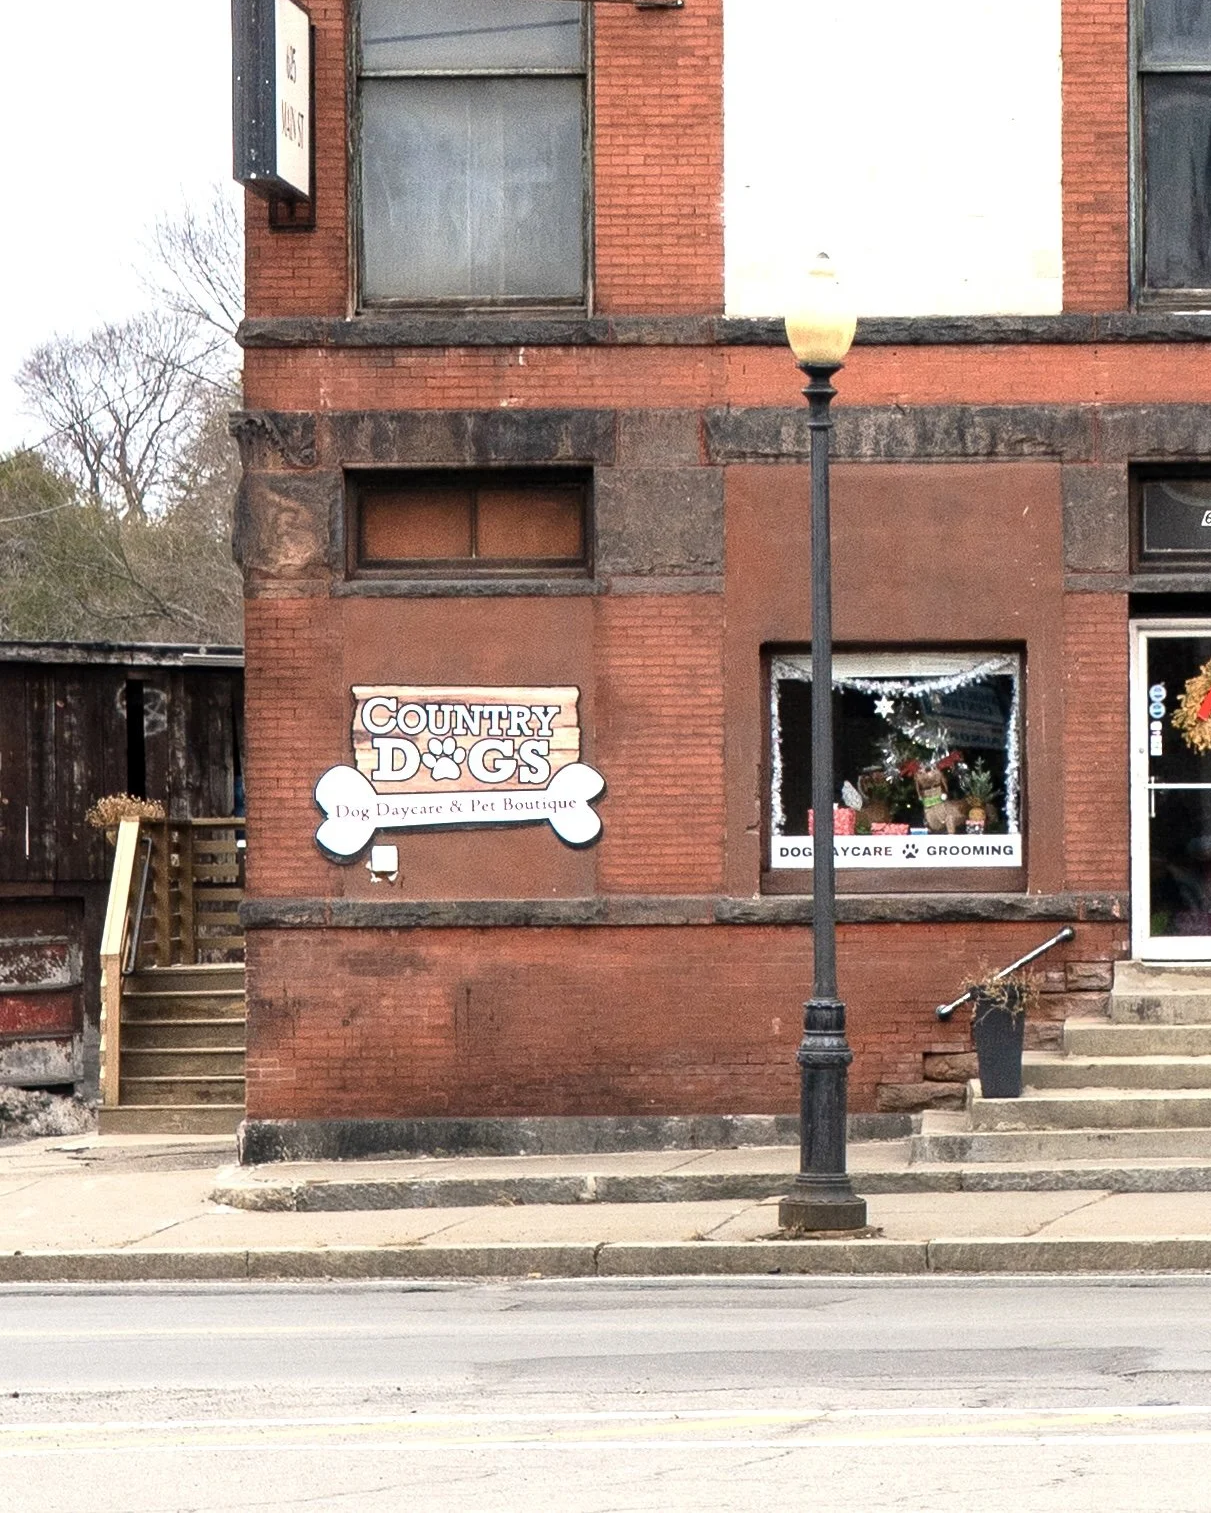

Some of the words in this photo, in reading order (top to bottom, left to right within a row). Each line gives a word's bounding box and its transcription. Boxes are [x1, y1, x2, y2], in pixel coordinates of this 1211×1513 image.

[361, 696, 561, 736] COUNTRY
[336, 803, 370, 820] Dog
[376, 802, 443, 819] Daycare
[449, 800, 464, 813] &
[471, 798, 496, 812] Pet
[503, 797, 577, 816] Boutique
[779, 846, 813, 857] DOG
[832, 846, 893, 857] AYCARE
[926, 844, 1014, 857] GROOMING
